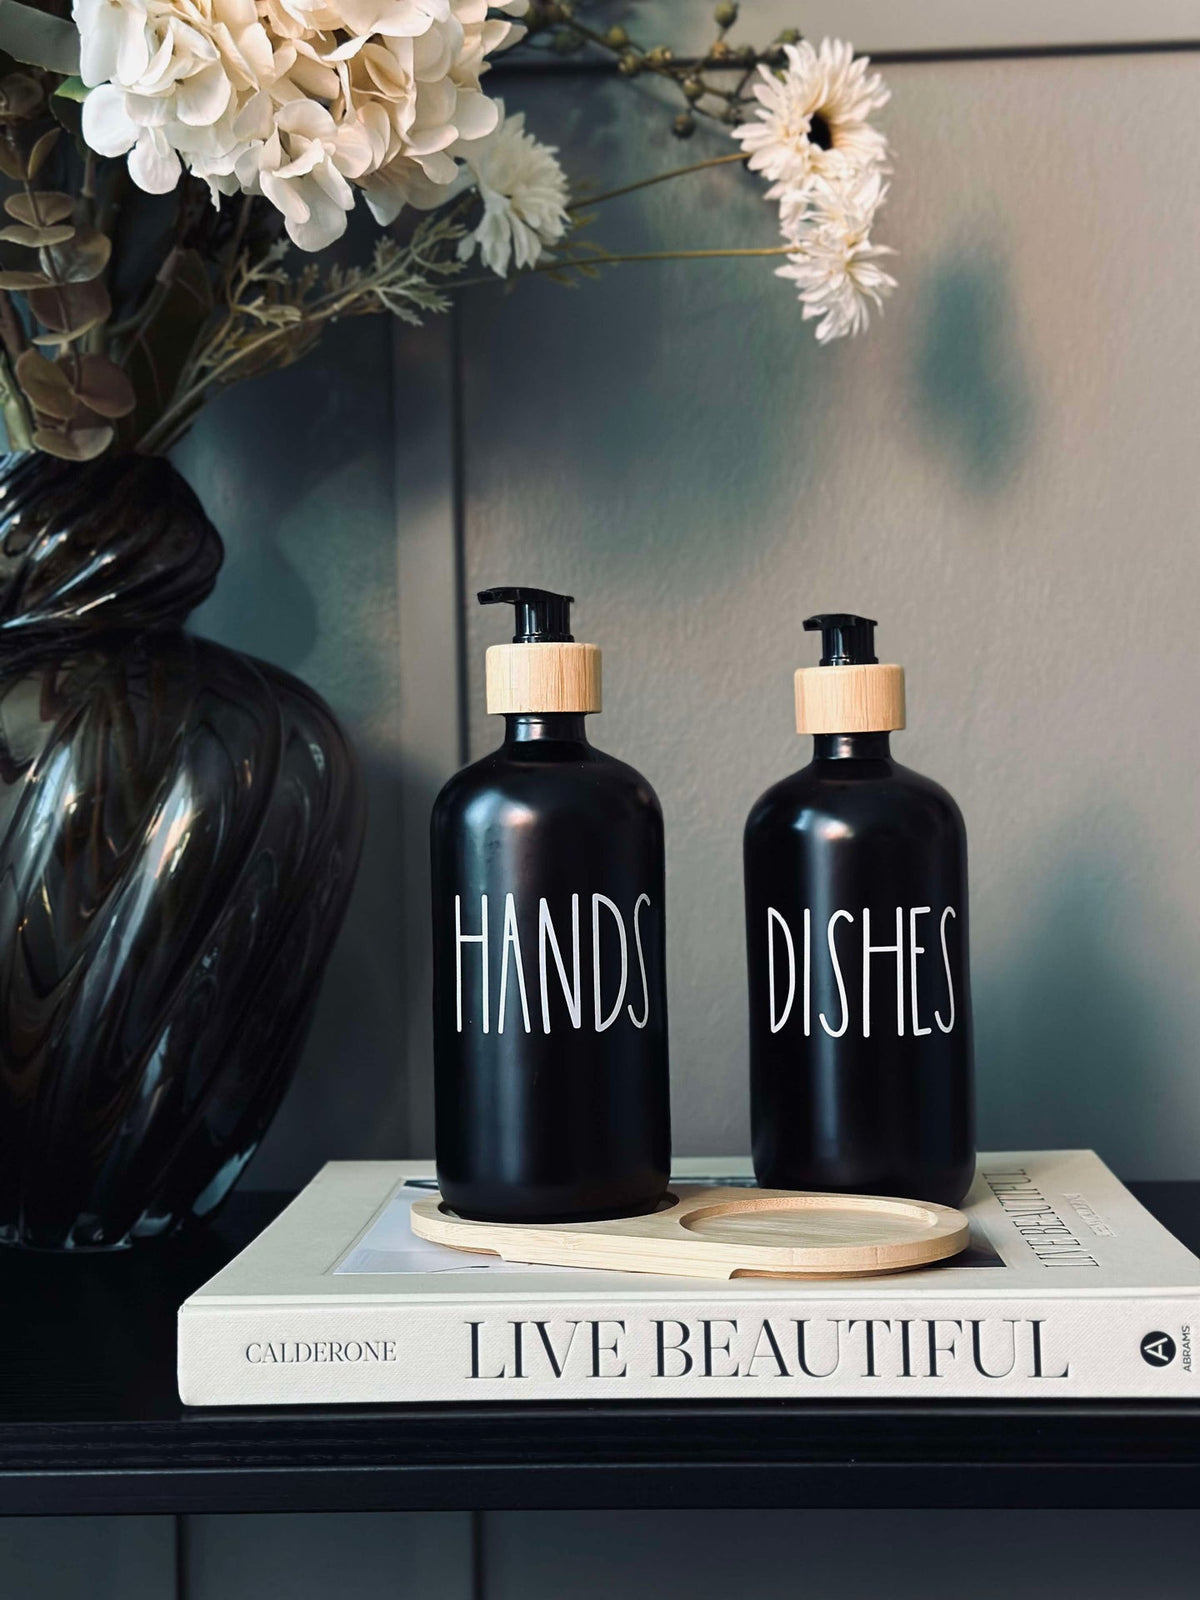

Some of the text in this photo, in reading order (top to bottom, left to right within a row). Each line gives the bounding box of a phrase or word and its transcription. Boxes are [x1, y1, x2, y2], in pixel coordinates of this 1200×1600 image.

[455, 893, 651, 1034] HANDS
[767, 906, 957, 1038] DISHES
[982, 1169, 1072, 1236] BEAUTIFUL
[245, 1341, 397, 1364] CALDERONE
[464, 1319, 1070, 1379] LIVE BEAUTIFUL
[1182, 1325, 1192, 1373] ABRAMS
